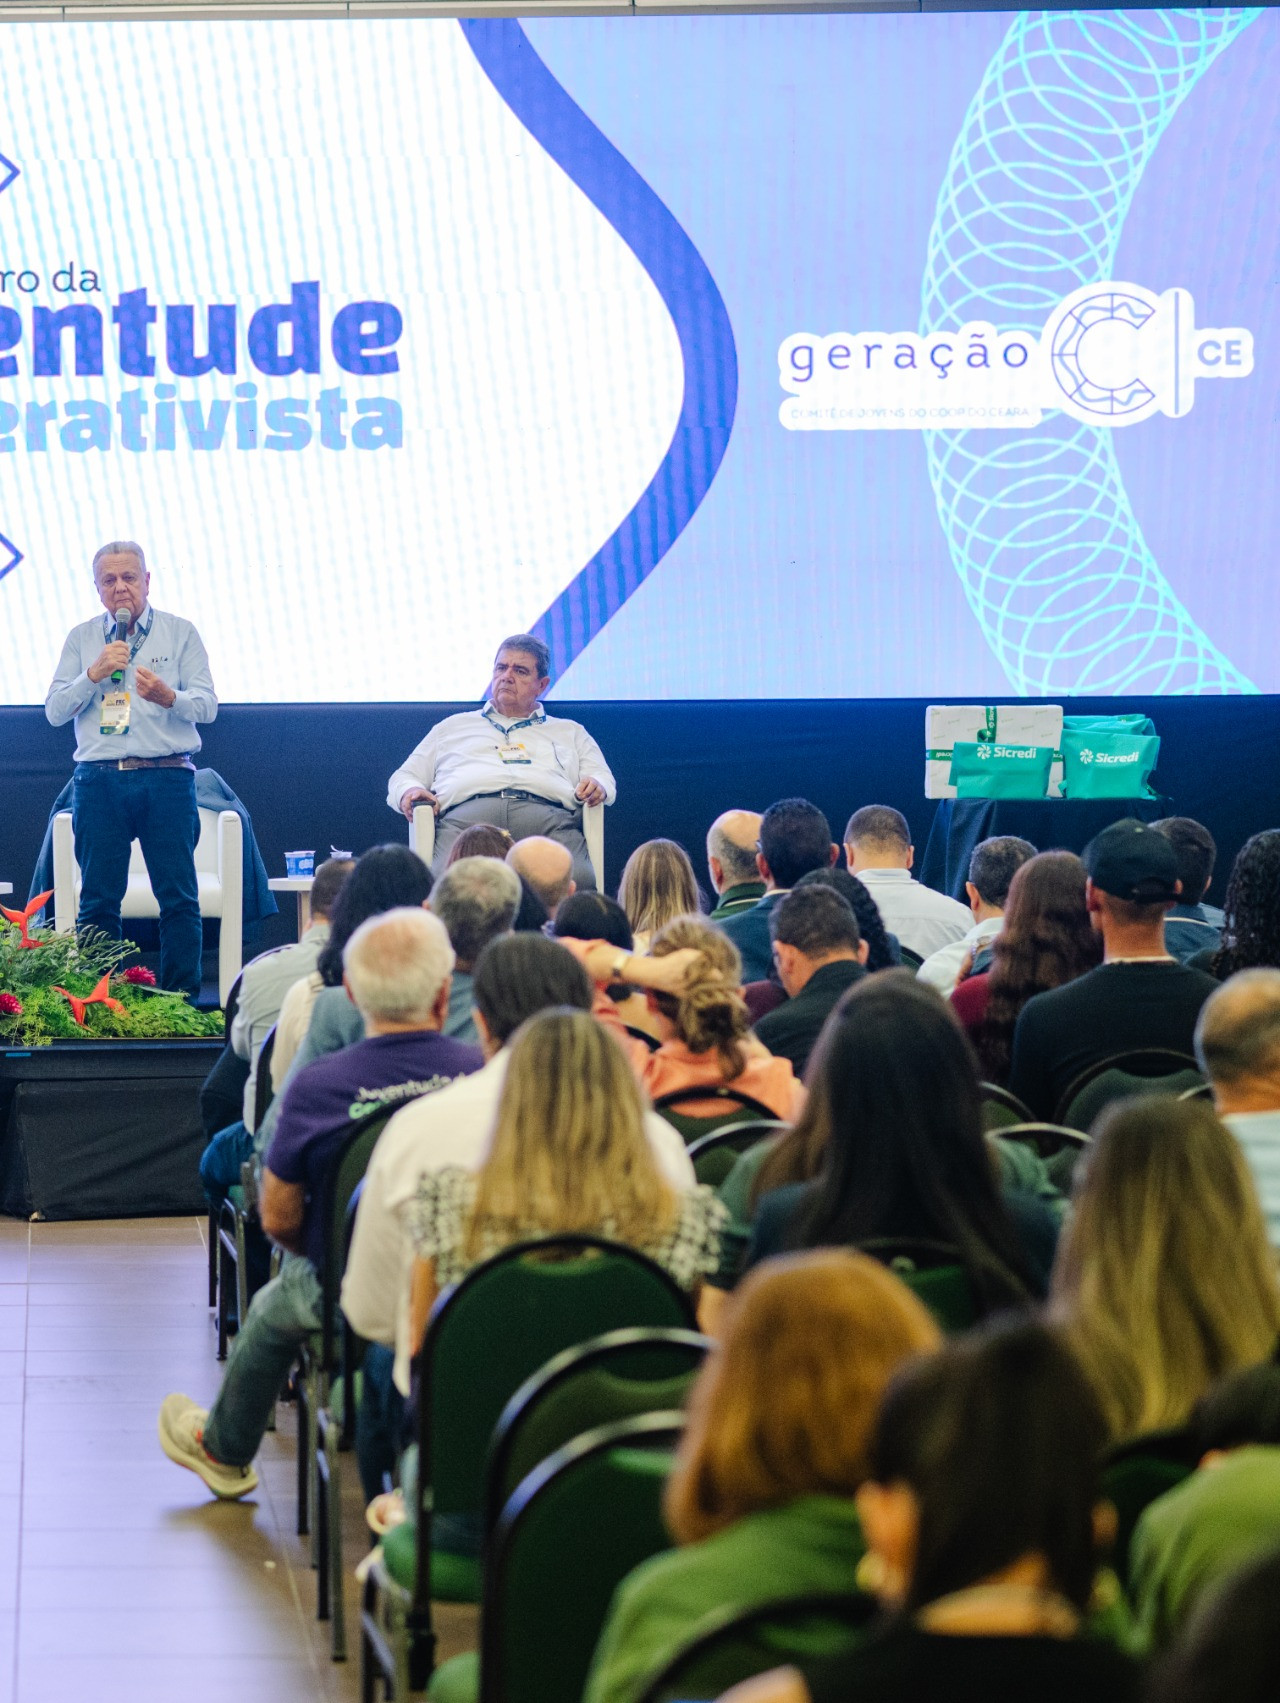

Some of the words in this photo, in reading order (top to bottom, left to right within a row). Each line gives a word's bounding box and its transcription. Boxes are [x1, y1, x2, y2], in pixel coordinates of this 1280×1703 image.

[51, 262, 102, 293] da
[790, 332, 1029, 382] geração
[1198, 339, 1243, 366] CE
[909, 408, 927, 419] DO
[929, 407, 965, 419] COOP
[968, 408, 987, 418] DO
[993, 746, 1037, 759] Sicredi
[1095, 752, 1139, 764] Sicredi
